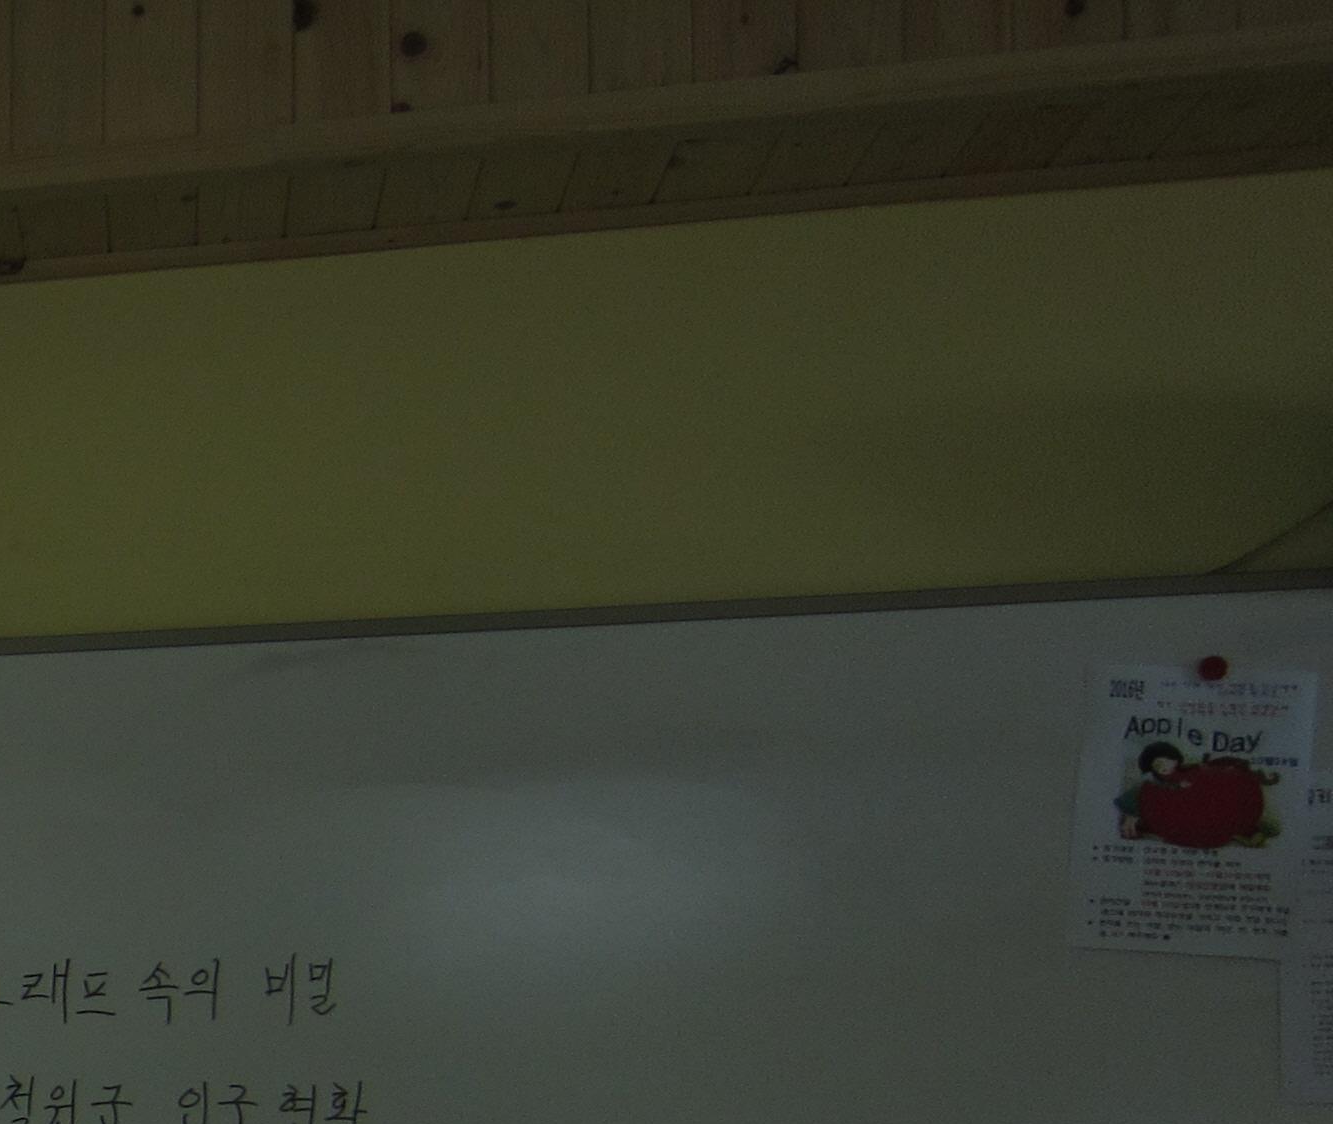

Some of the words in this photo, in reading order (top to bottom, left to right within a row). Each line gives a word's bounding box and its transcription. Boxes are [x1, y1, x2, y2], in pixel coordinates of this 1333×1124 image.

[1123, 715, 1203, 746] Apple
[1211, 730, 1264, 753] Day
[139, 957, 220, 1024] 속의
[263, 952, 337, 1026] 비밀
